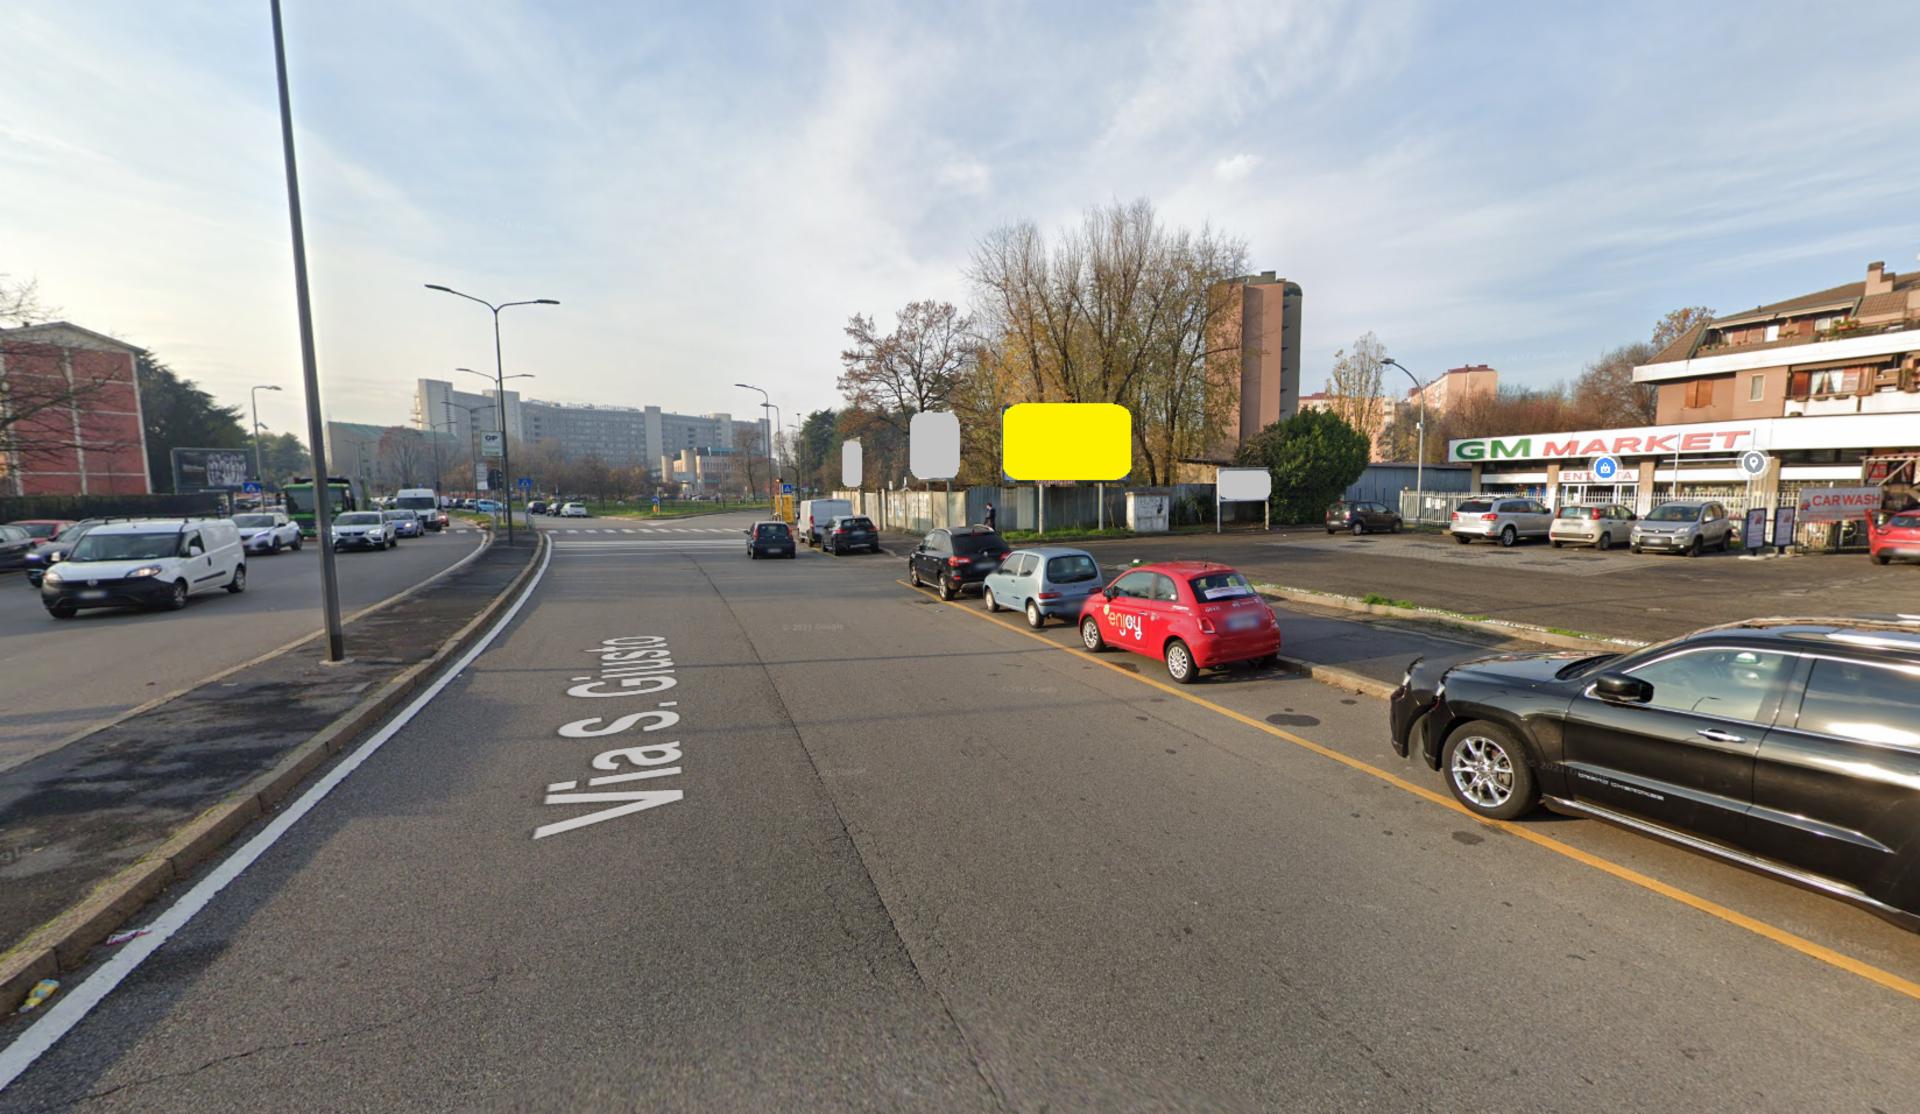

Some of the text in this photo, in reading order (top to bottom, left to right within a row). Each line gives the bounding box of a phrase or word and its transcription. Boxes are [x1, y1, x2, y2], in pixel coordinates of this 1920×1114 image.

[1456, 431, 1751, 460] GM MARKET
[1812, 493, 1880, 506] CAR WASH
[1108, 612, 1142, 640] enjoy
